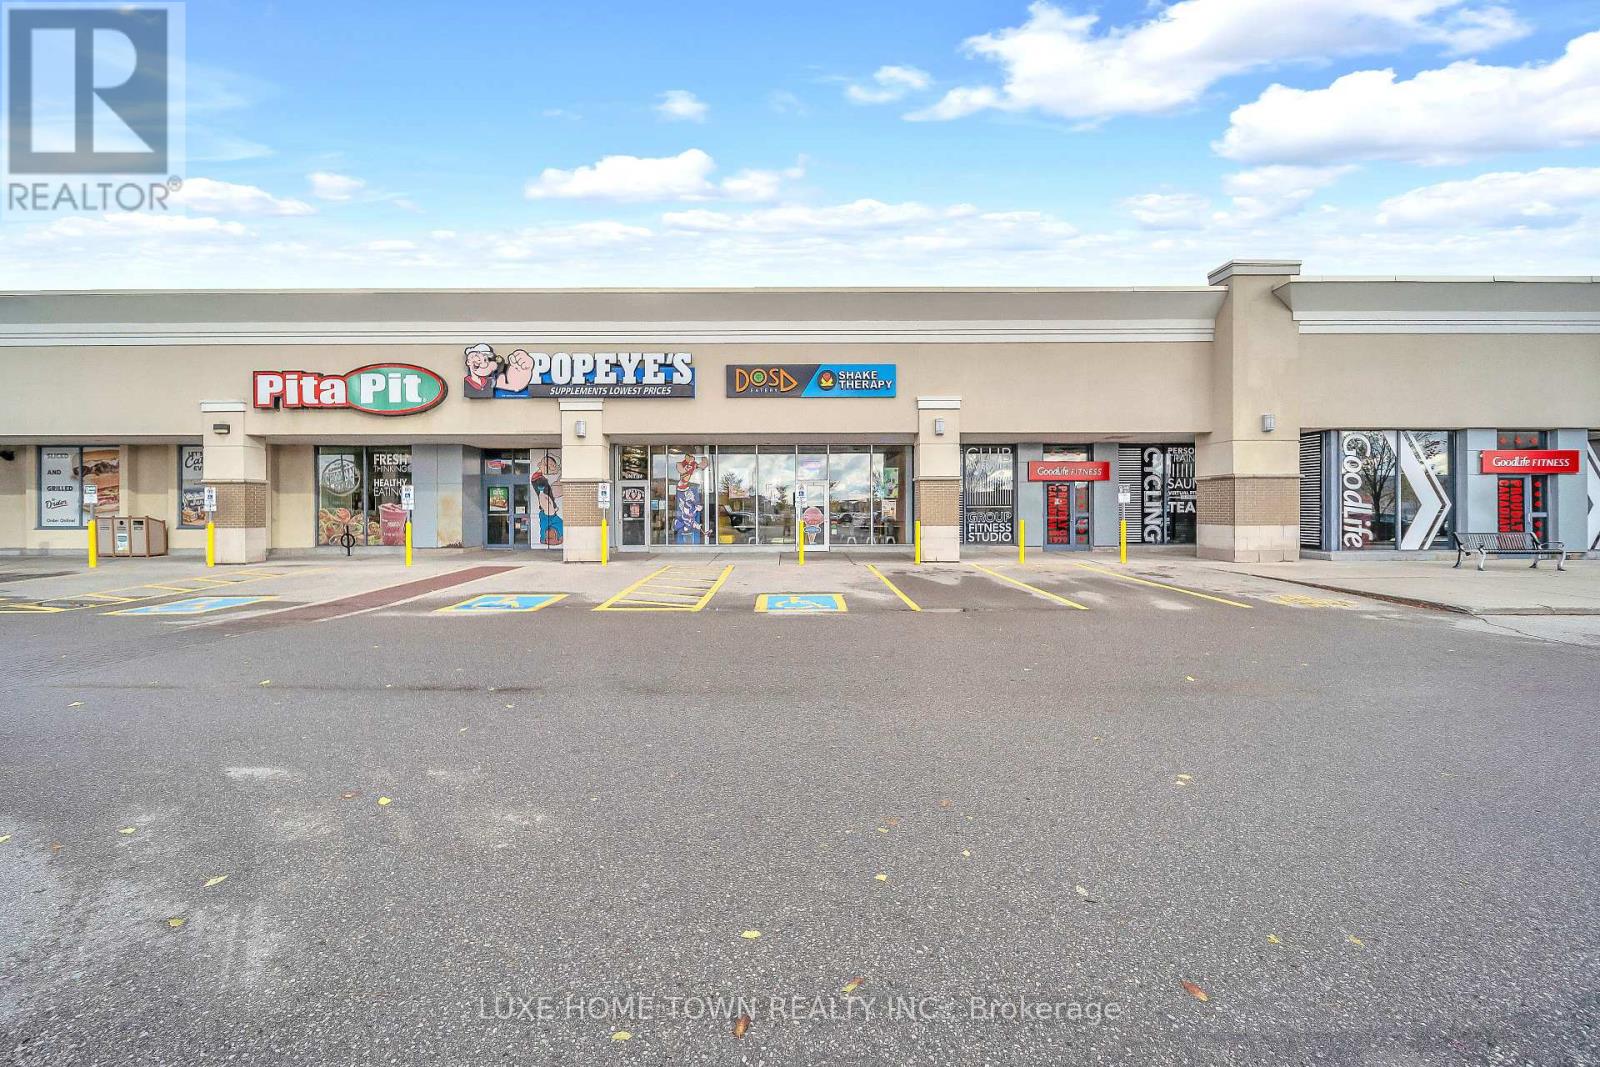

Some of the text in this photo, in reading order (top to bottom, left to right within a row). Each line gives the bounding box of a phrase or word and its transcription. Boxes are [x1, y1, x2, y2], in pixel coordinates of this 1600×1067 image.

[529, 352, 693, 385] POPEYE'S
[838, 370, 877, 380] SHAKE
[735, 368, 798, 393] DOSA
[838, 380, 893, 390] THERAPY
[255, 372, 423, 405] Pita Pit
[550, 386, 671, 395] SUPPLEMENTS LOWEST PRICES
[1167, 447, 1195, 455] PERSO
[373, 453, 408, 466] FRESH
[1492, 456, 1570, 467] GoodLife FITNESS
[1037, 466, 1103, 476] GoodLife FITNESS
[373, 478, 408, 487] HEALTHY
[1143, 447, 1162, 543] CYCLING
[1342, 433, 1373, 548] GoodLife
[968, 511, 1012, 523] GROUP
[968, 523, 1012, 533] FITNESS
[968, 532, 1012, 542] STUDIO
